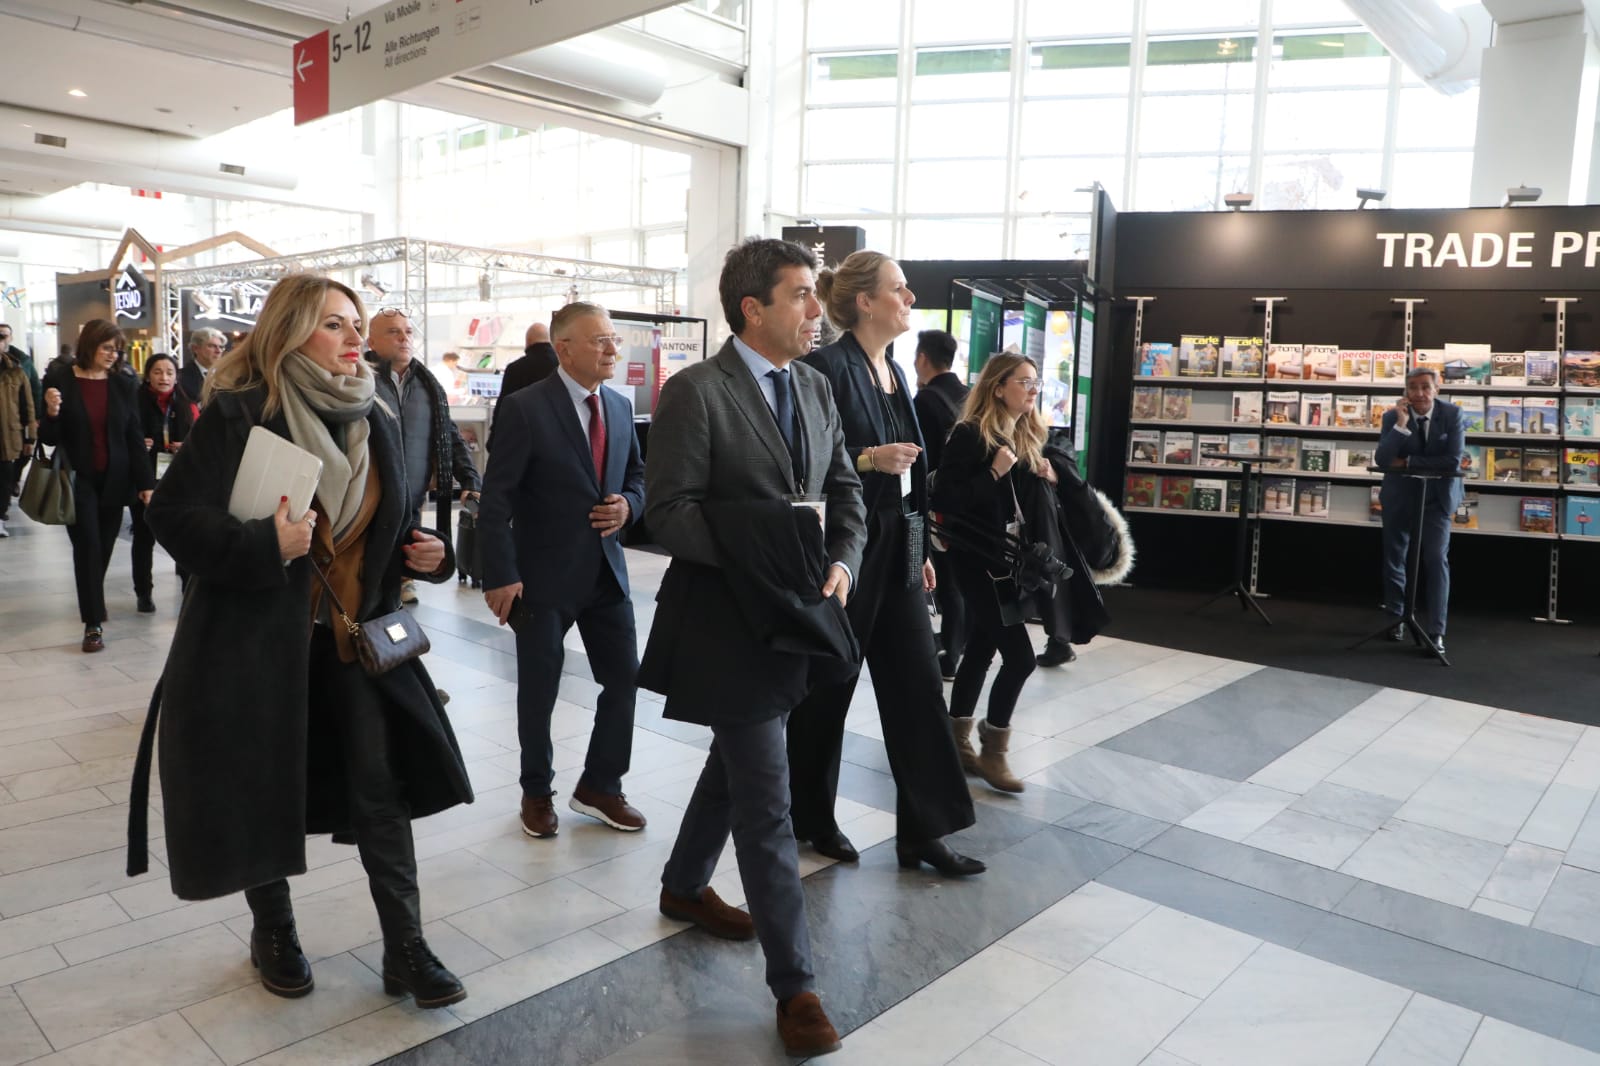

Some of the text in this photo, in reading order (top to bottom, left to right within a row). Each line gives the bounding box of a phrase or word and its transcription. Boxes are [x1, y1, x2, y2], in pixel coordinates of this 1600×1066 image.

[384, 0, 422, 24] Via Mobile
[332, 21, 371, 63] 5-12
[384, 26, 440, 55] Alle Richtungen
[384, 46, 427, 69] All directions
[1376, 232, 1535, 268] TRADE
